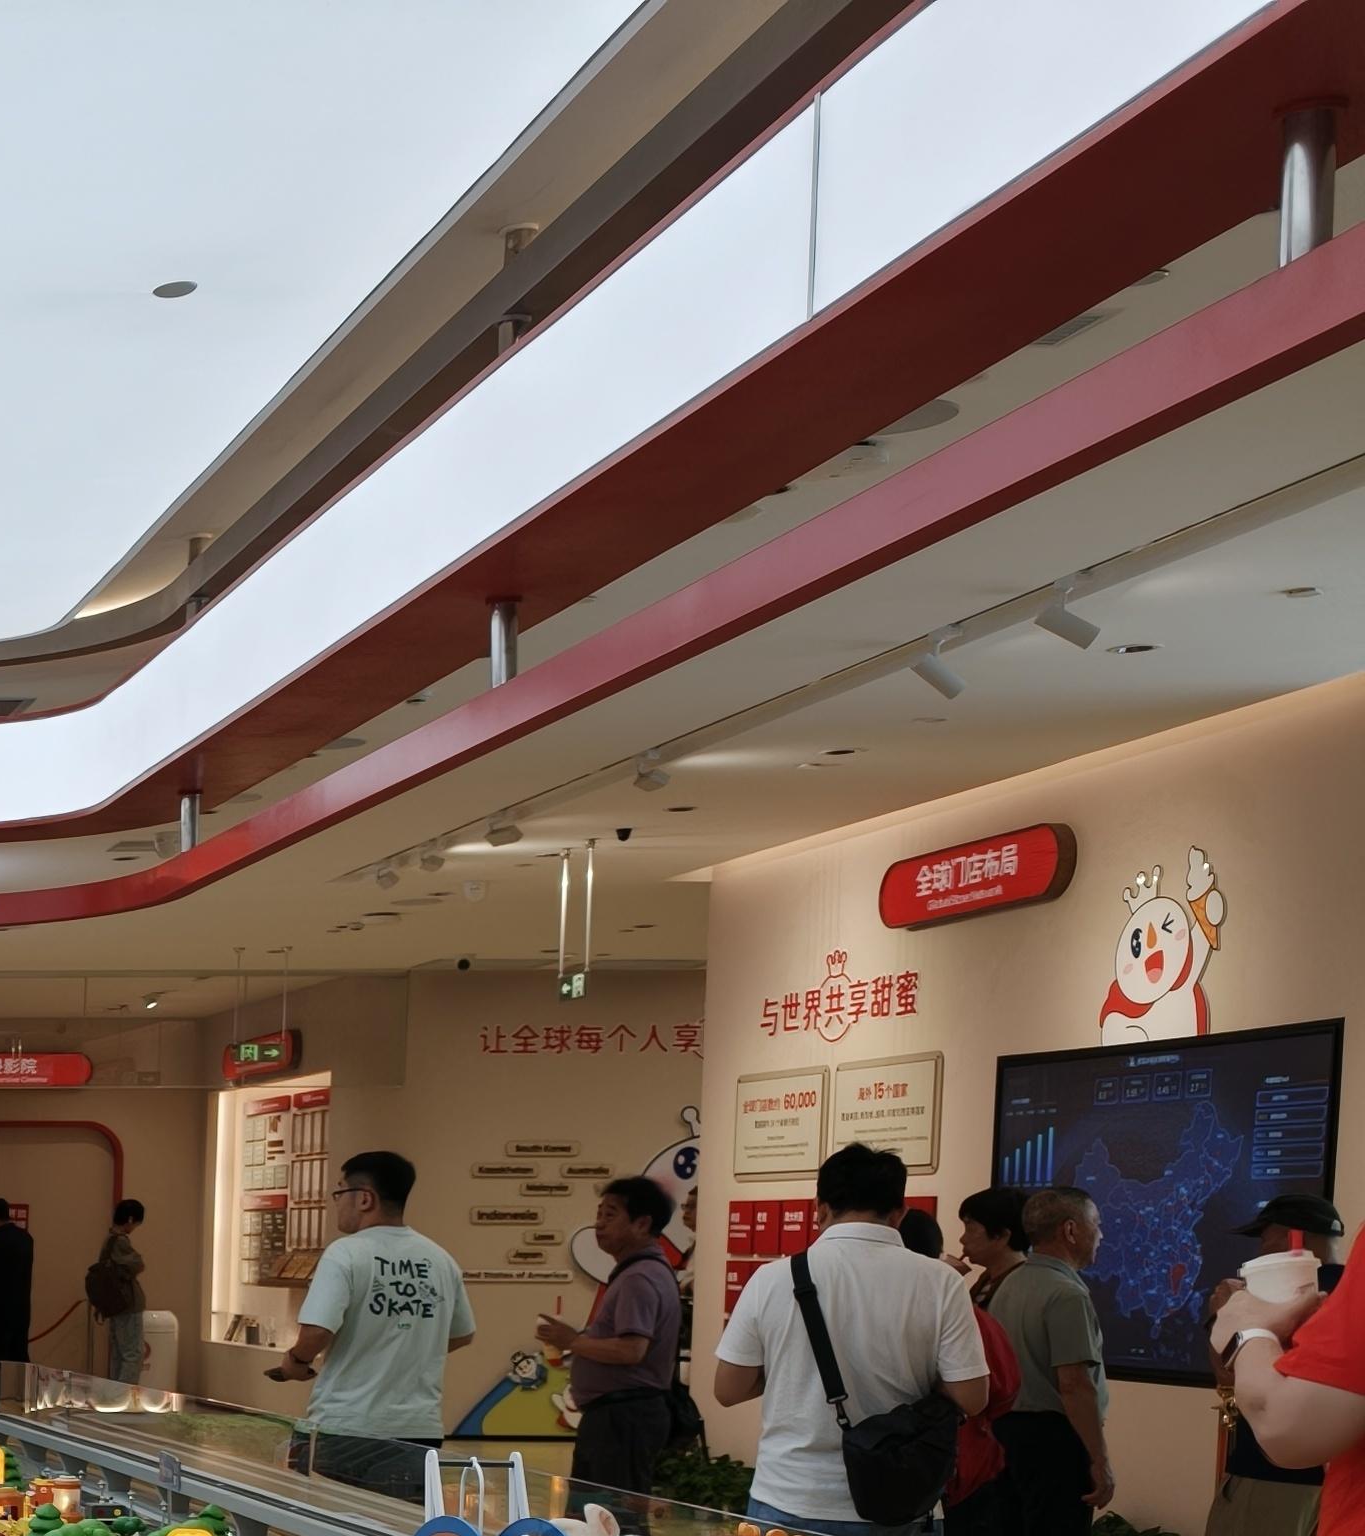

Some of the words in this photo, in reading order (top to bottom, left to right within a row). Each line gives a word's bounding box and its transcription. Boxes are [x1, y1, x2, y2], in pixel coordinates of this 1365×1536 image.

[915, 844, 1018, 897] 全球门店布局
[760, 971, 919, 1036] 与世界共享甜蜜
[479, 1023, 702, 1055] 让全球每个人享
[783, 1090, 818, 1112] 60,000
[374, 1256, 429, 1279] TIME
[389, 1281, 417, 1297] TO
[369, 1292, 434, 1318] SKATE
